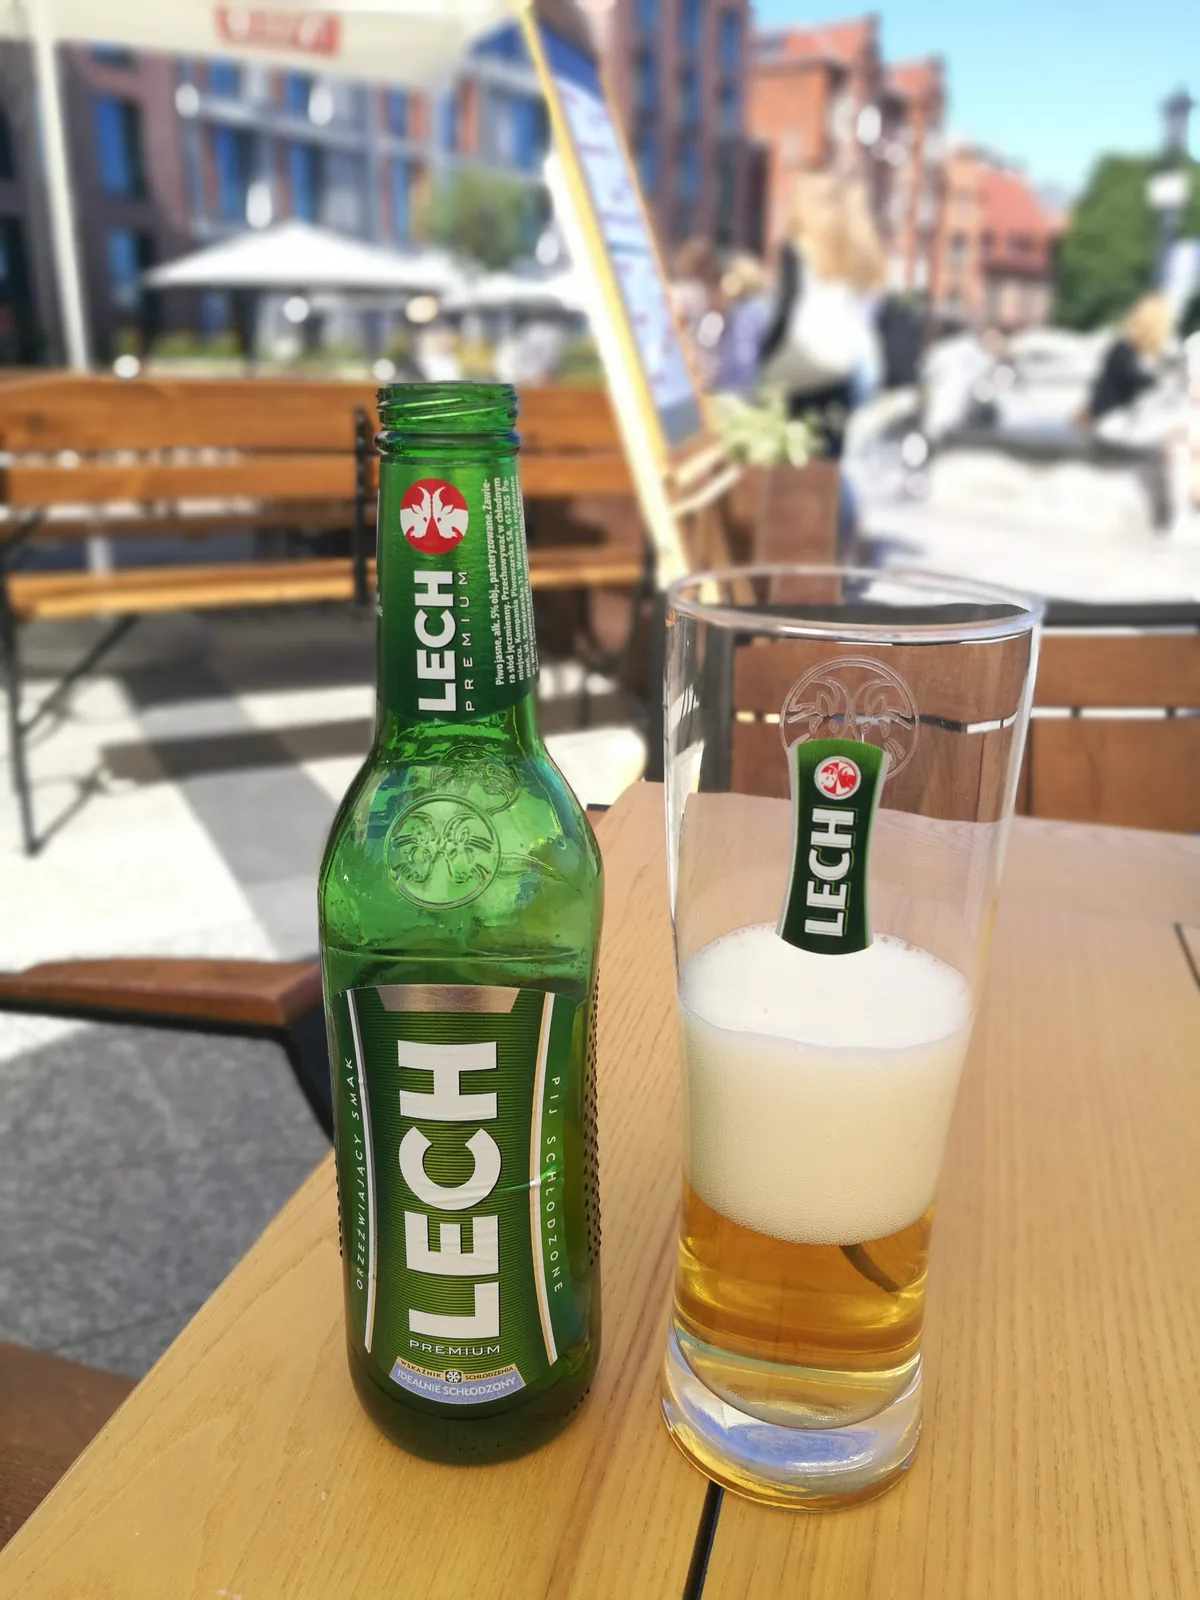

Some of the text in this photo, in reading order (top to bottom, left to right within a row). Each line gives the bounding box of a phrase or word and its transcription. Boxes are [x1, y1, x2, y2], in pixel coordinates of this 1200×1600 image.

[481, 479, 492, 510] Zawie-
[502, 476, 510, 492] Po-
[504, 495, 512, 524] 61-285
[486, 511, 499, 583] pasteryzowane.
[494, 477, 516, 684] ra słód jęczmienny. Przechowywać w chłodnym
[508, 544, 518, 597] Piwowarska
[490, 605, 499, 618] 5%
[491, 619, 501, 636] alk.
[512, 600, 521, 643] Kompania
[519, 587, 528, 639] Szwajcarska
[414, 570, 456, 712] LECH
[458, 571, 475, 712] PREMIUM
[493, 637, 505, 664] jasne,
[495, 664, 505, 685] Piwo
[516, 645, 525, 681] miejscu.
[804, 808, 855, 937] LECH
[345, 1058, 367, 1290] ORZEŹWIAJĄCY SMAK
[398, 1040, 502, 1338] LECH
[545, 1076, 564, 1293] PIJ SCHŁODZONE
[409, 1340, 500, 1356] PREMIUM
[397, 1370, 516, 1396] IDEALNIE SCHŁODZONY
[400, 1359, 514, 1381] WSKAŹNIK SCHŁODZENIA
